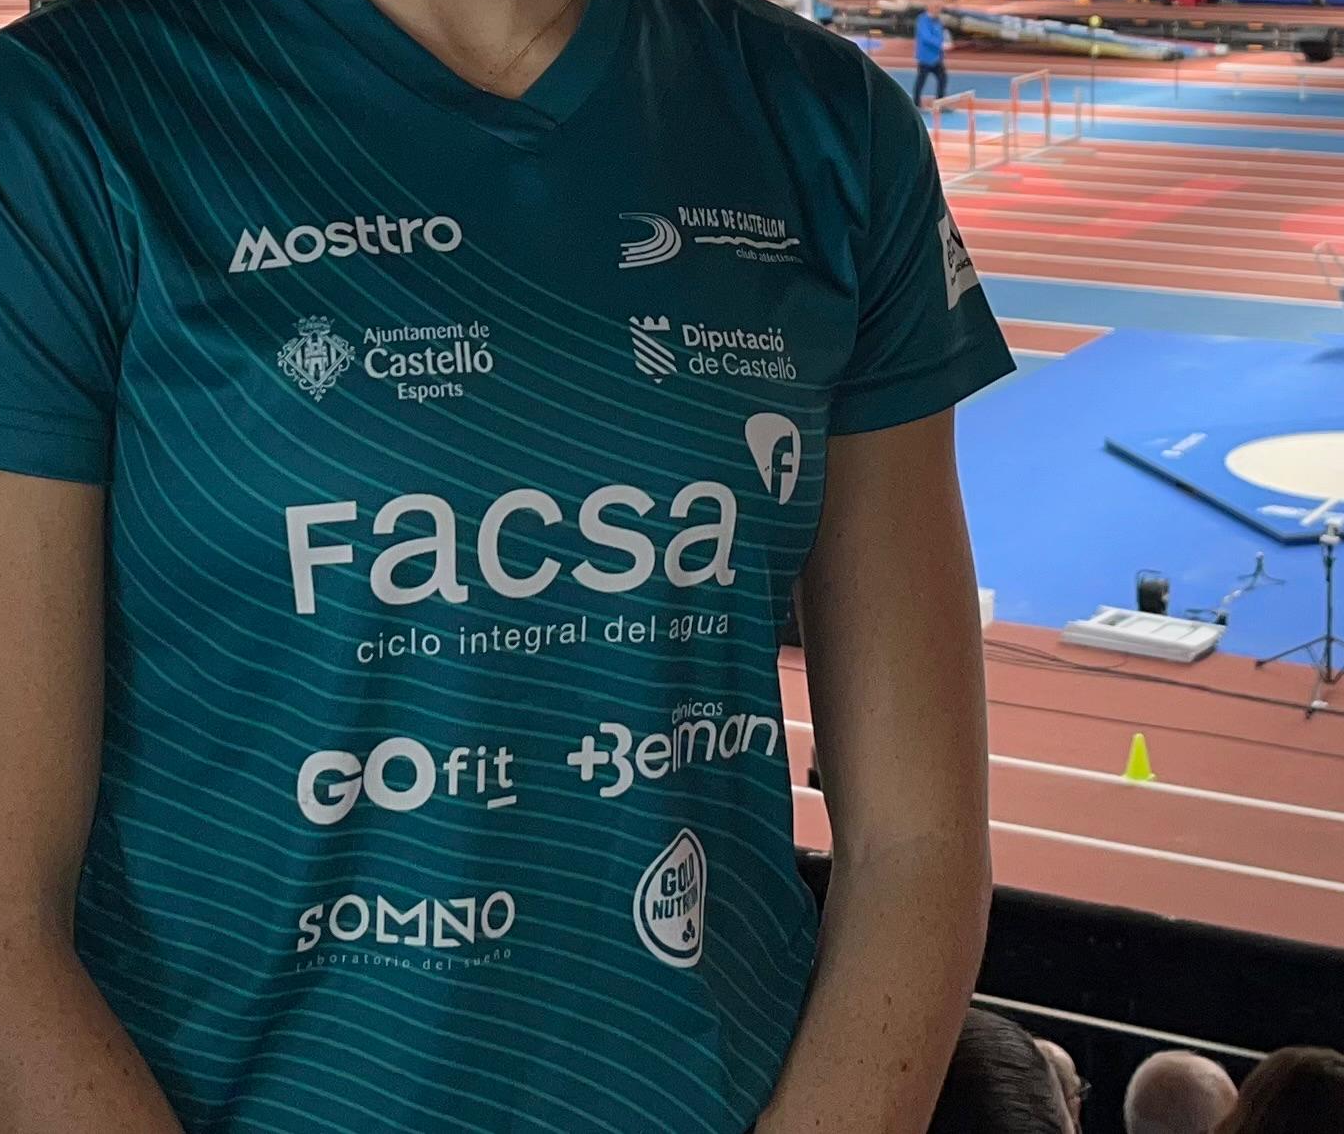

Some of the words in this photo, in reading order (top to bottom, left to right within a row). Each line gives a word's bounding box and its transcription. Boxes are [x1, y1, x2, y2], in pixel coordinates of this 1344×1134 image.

[677, 205, 720, 227] PLAYAS
[720, 208, 736, 230] DE
[736, 211, 787, 239] CASTELLON
[228, 214, 463, 274] Mosttro
[736, 247, 758, 261] club
[362, 322, 464, 348] Ajuntament
[468, 320, 490, 339] de
[682, 323, 785, 353] Diputació
[362, 340, 494, 379] Castelló
[688, 351, 719, 375] de
[722, 352, 797, 380] Castelló
[397, 380, 464, 404] Esports
[356, 627, 442, 664] ciclo
[458, 615, 588, 656] integral
[603, 614, 657, 644] del
[668, 611, 730, 643] agua
[297, 890, 516, 953] SOMNO
[422, 957, 452, 970] del
